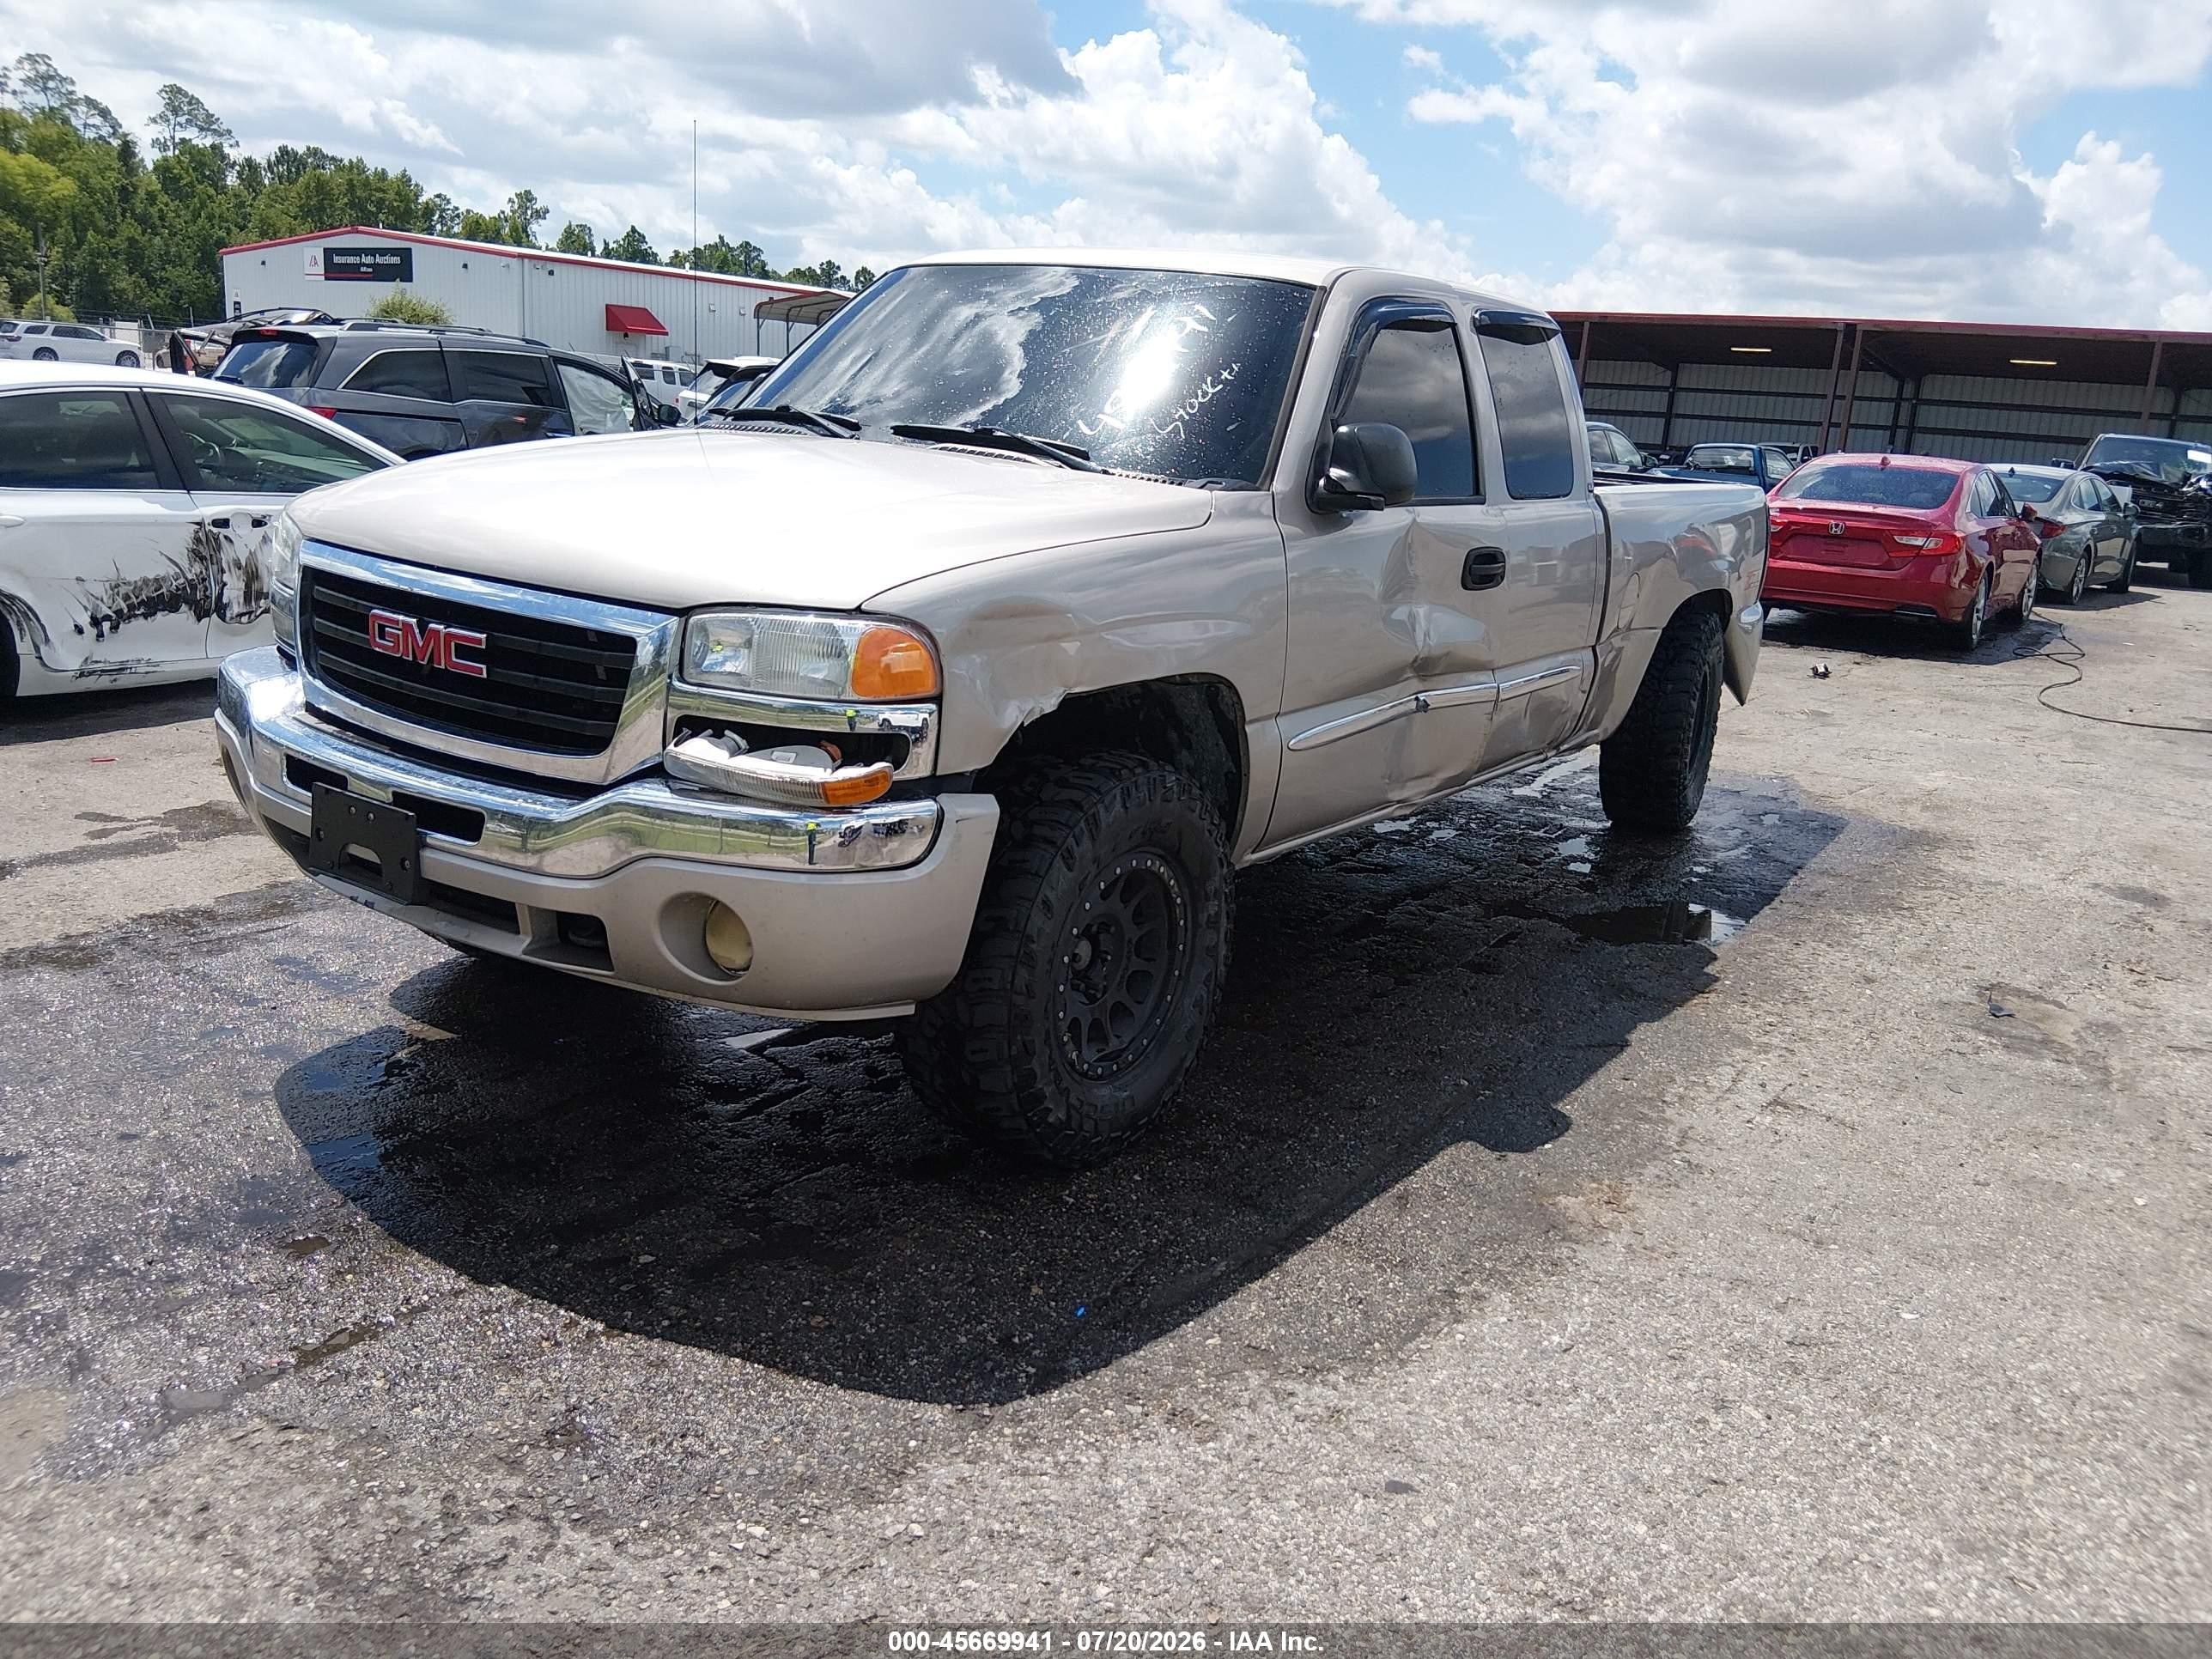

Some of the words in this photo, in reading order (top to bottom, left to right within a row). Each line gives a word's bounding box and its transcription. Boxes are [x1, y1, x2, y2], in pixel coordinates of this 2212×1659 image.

[333, 253, 360, 264] Insurance
[362, 253, 374, 264] Auto
[375, 253, 401, 264] Auctions
[369, 609, 487, 678] GMC
